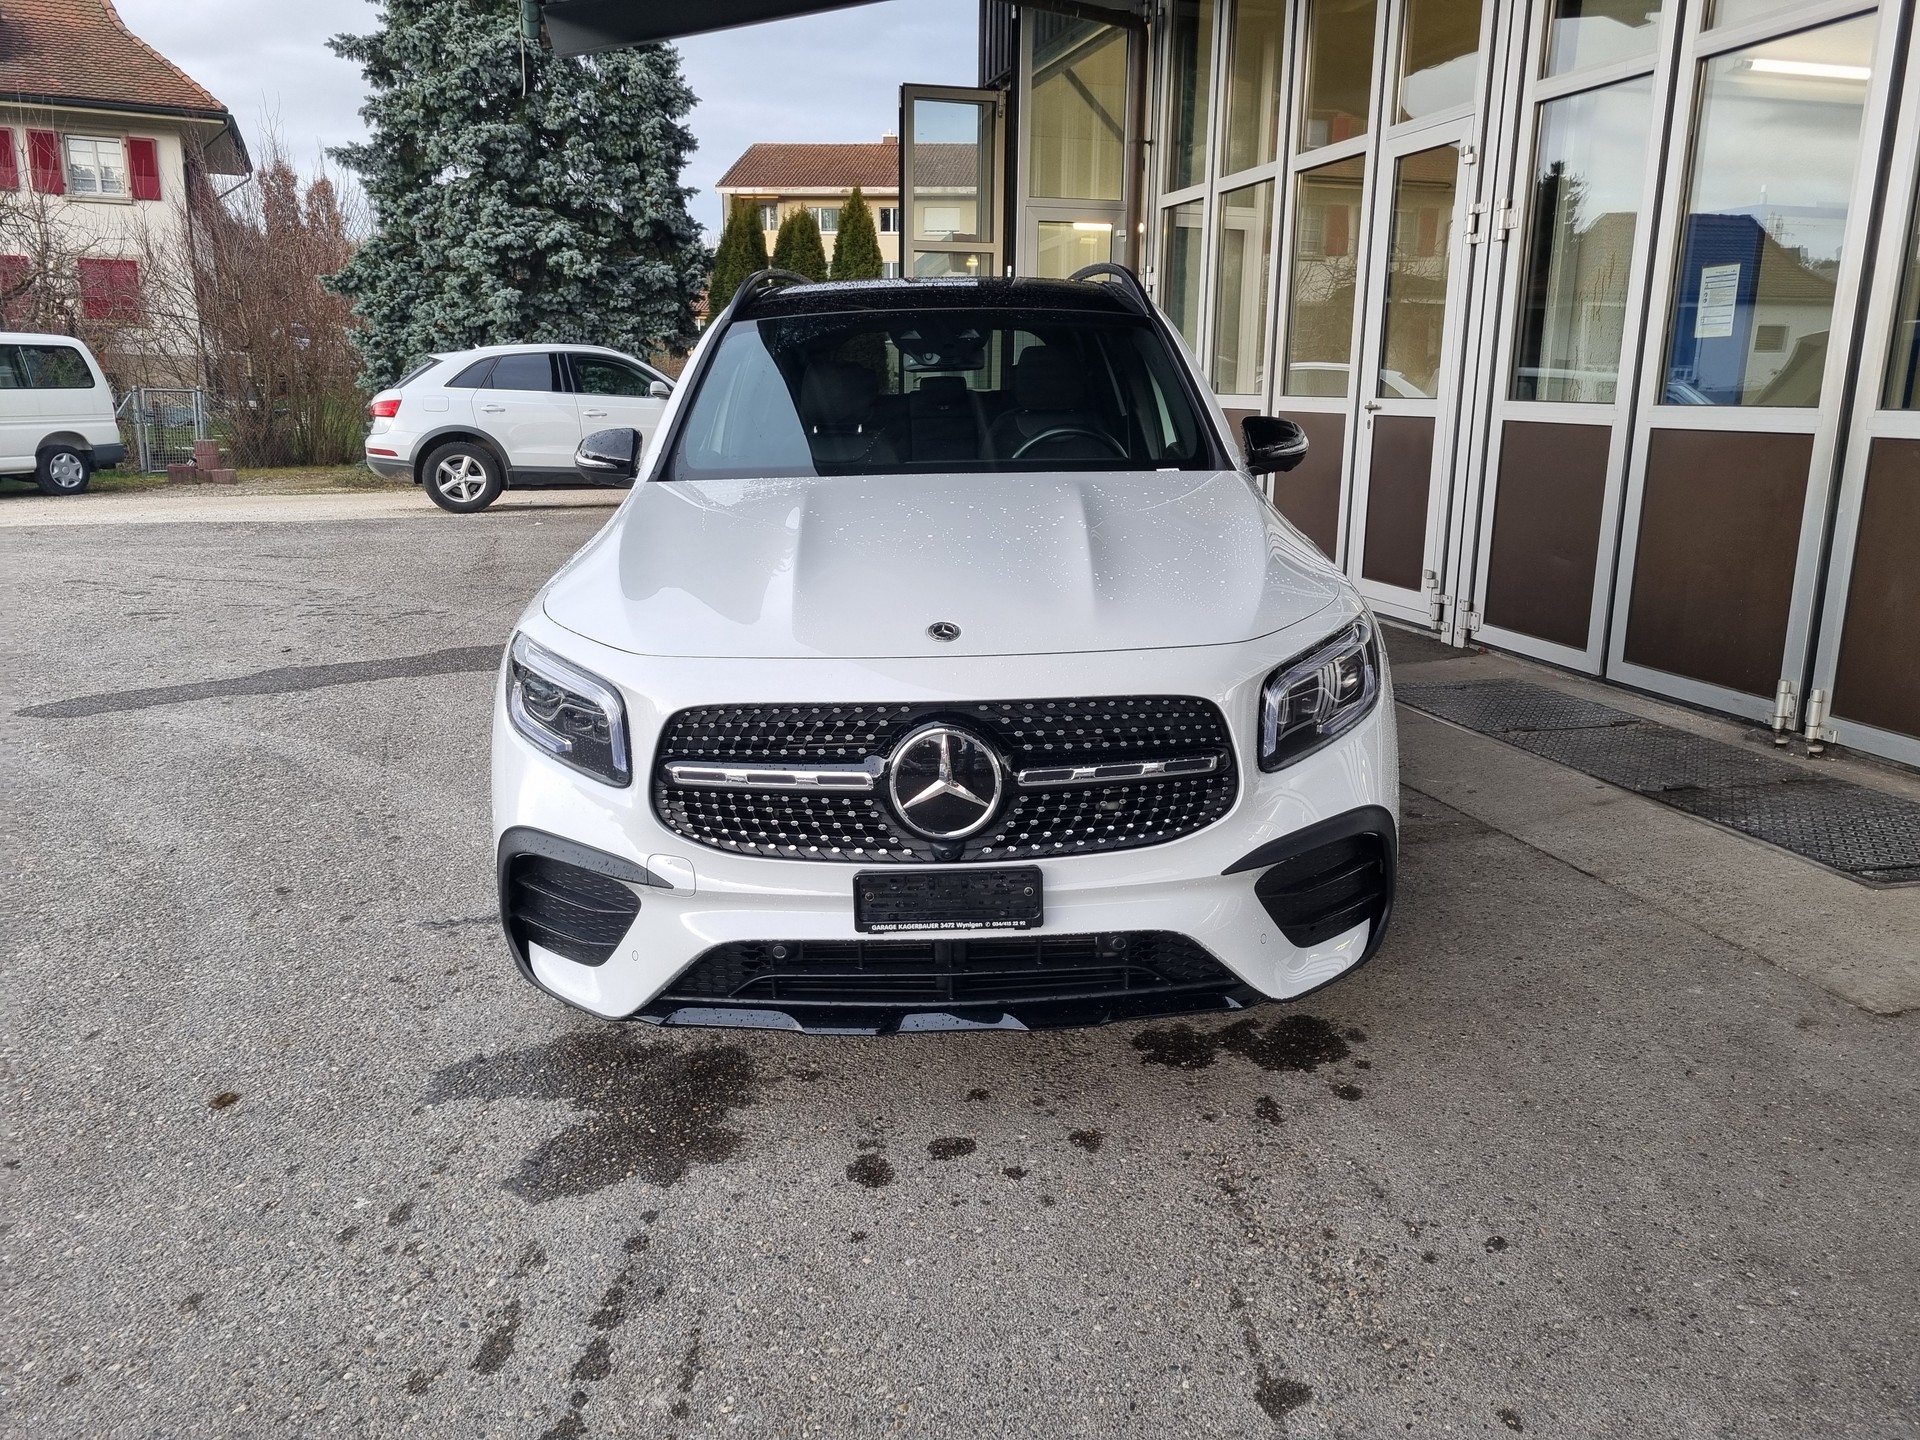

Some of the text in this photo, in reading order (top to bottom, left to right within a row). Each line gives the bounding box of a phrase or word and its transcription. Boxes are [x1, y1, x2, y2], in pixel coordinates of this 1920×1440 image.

[871, 923, 897, 931] GARAGE
[898, 922, 939, 930] KAGERBAUER
[956, 921, 983, 929] Wynigen
